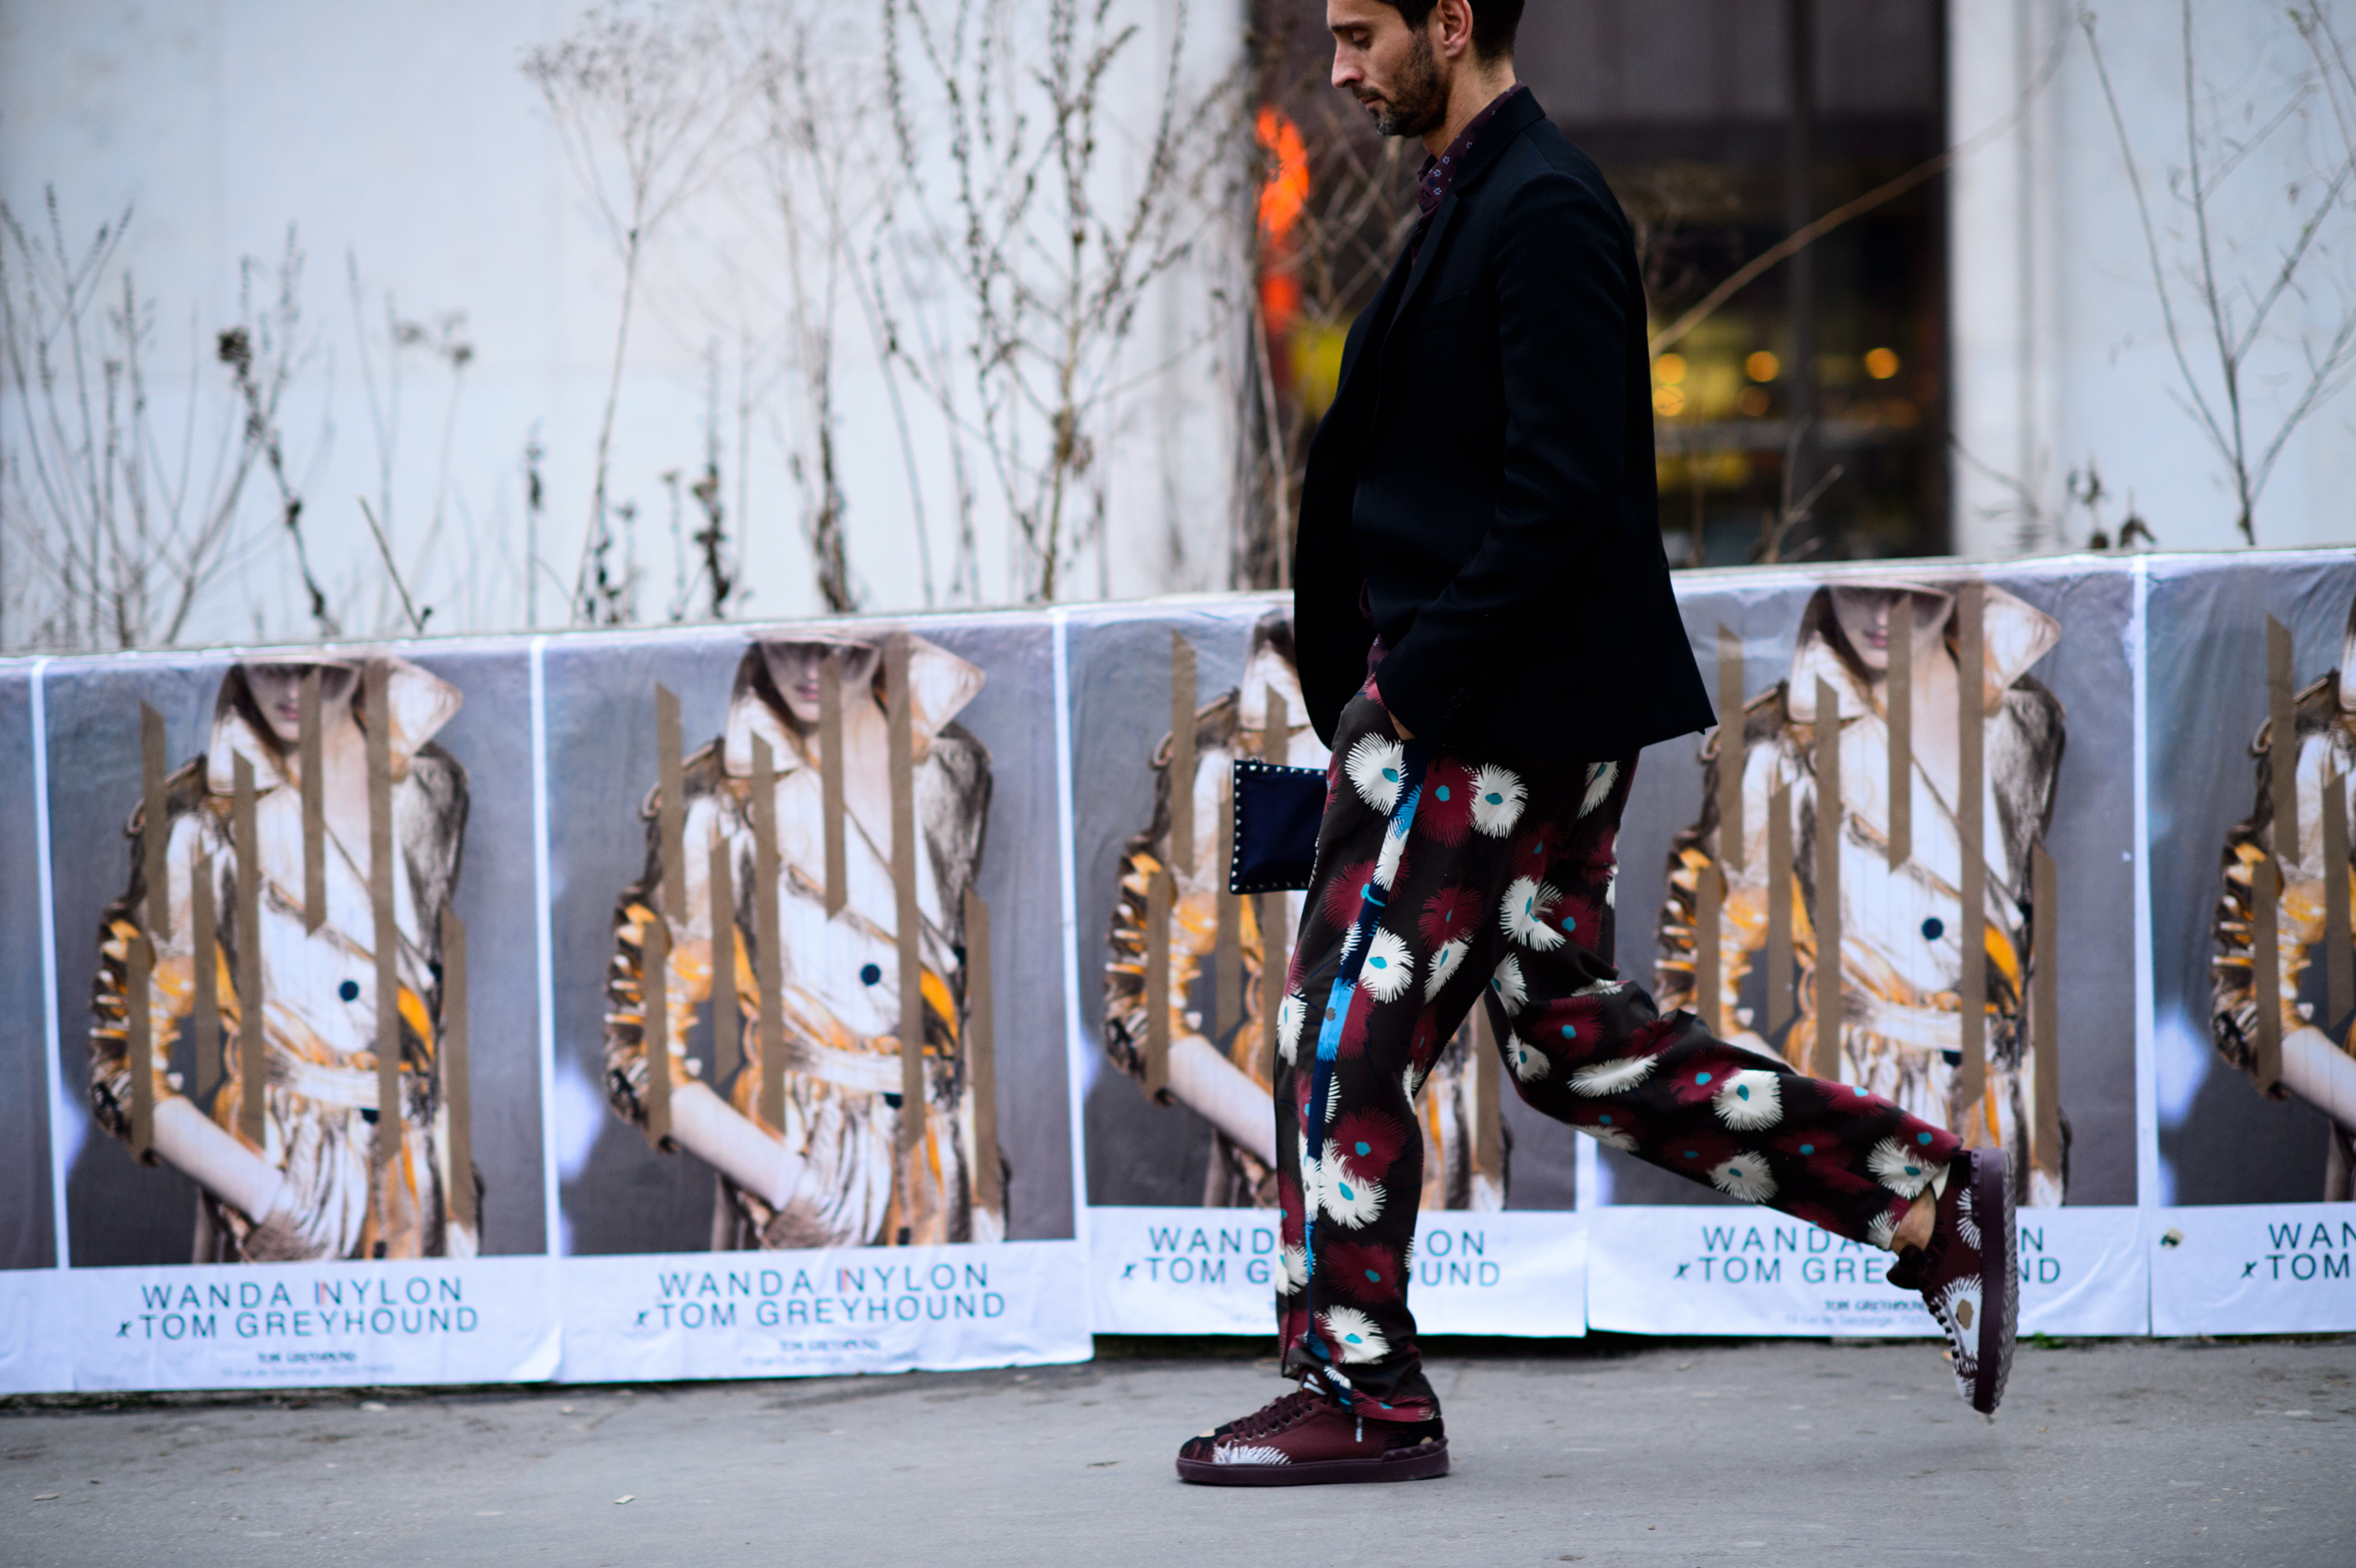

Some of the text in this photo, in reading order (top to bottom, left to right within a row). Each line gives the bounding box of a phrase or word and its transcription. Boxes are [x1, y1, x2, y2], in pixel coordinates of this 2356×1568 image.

[1148, 1227, 1275, 1255] WAND
[659, 1262, 988, 1298] WANDA NYLON
[1144, 1256, 1226, 1284] TOM
[1698, 1256, 1781, 1284] TOM
[2264, 1253, 2350, 1281] TOM
[141, 1277, 462, 1309] WANDA NYLON
[138, 1312, 216, 1340] TOM
[236, 1307, 478, 1338] GREYHOUND
[656, 1301, 737, 1329] TOM
[756, 1291, 1005, 1327] GREYHOUND
